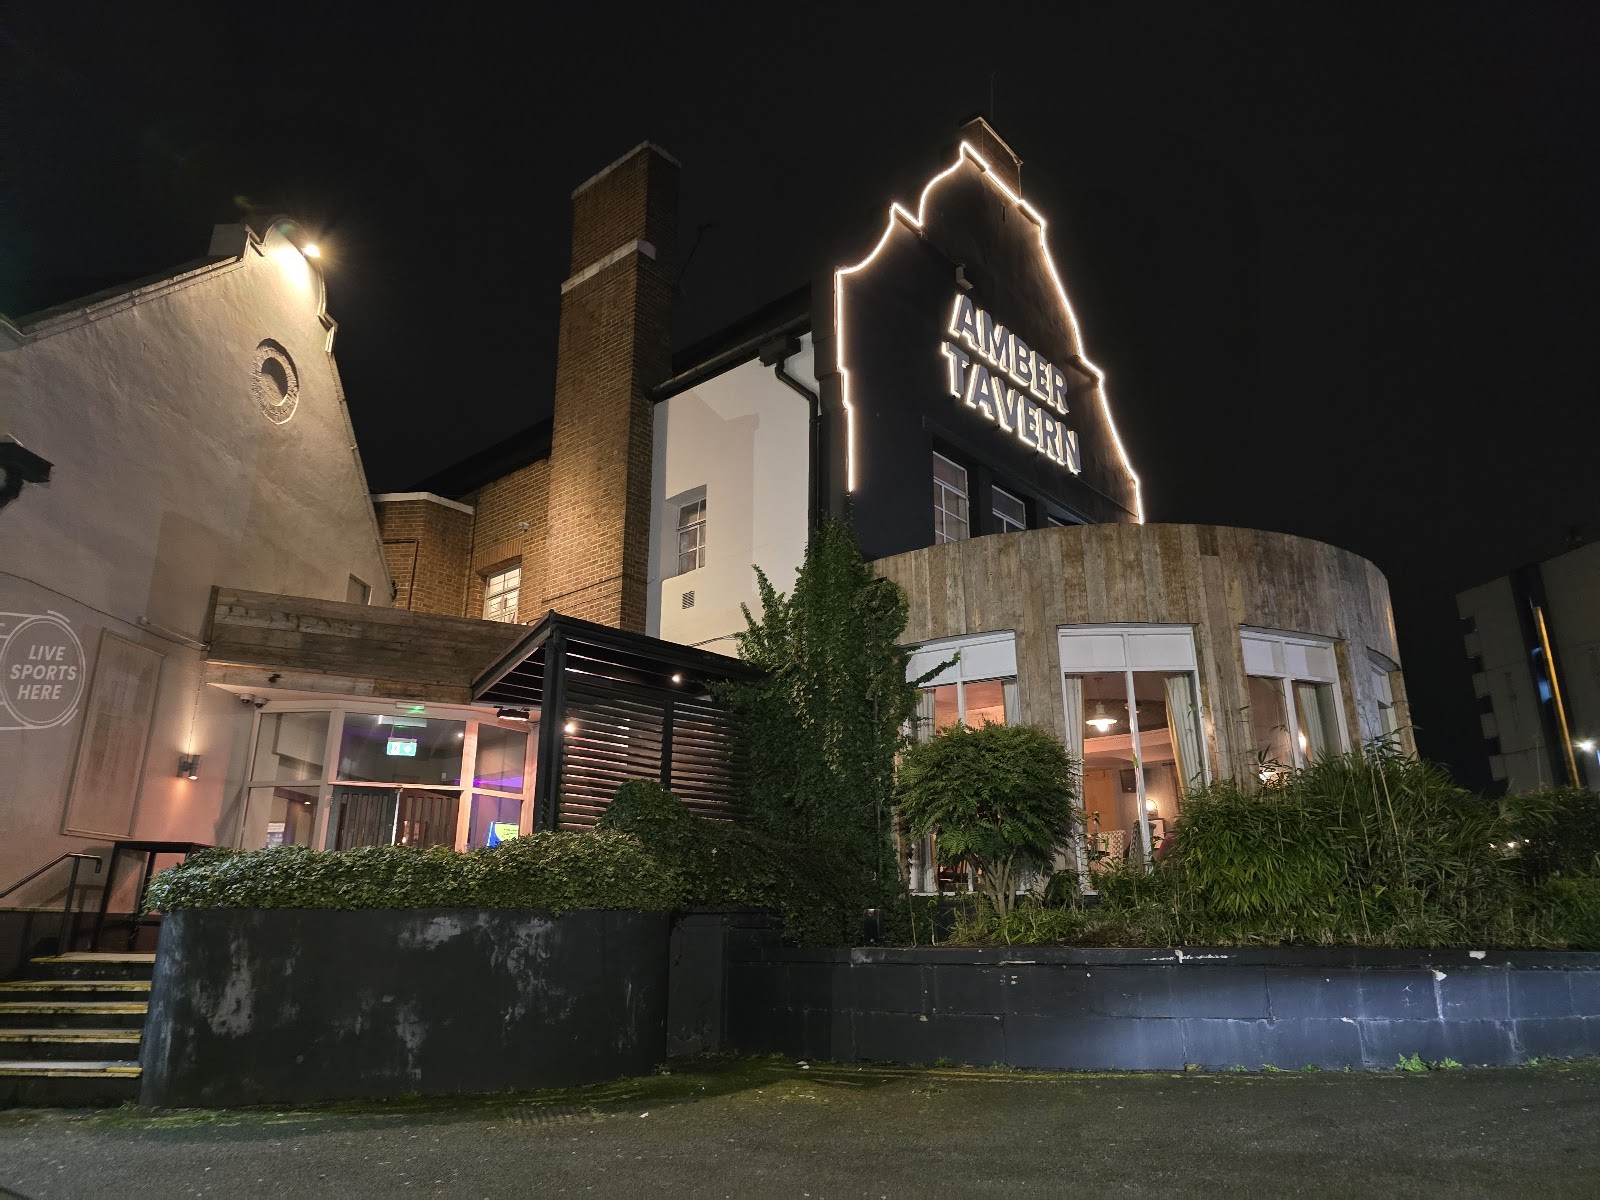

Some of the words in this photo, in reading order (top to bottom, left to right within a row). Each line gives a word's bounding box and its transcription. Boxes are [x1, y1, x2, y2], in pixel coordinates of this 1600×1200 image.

[949, 294, 1069, 414] AMBER
[941, 341, 1081, 475] TAVERN
[28, 645, 66, 661] LIVE
[9, 664, 78, 681] SPORTS
[17, 684, 63, 700] HERE
